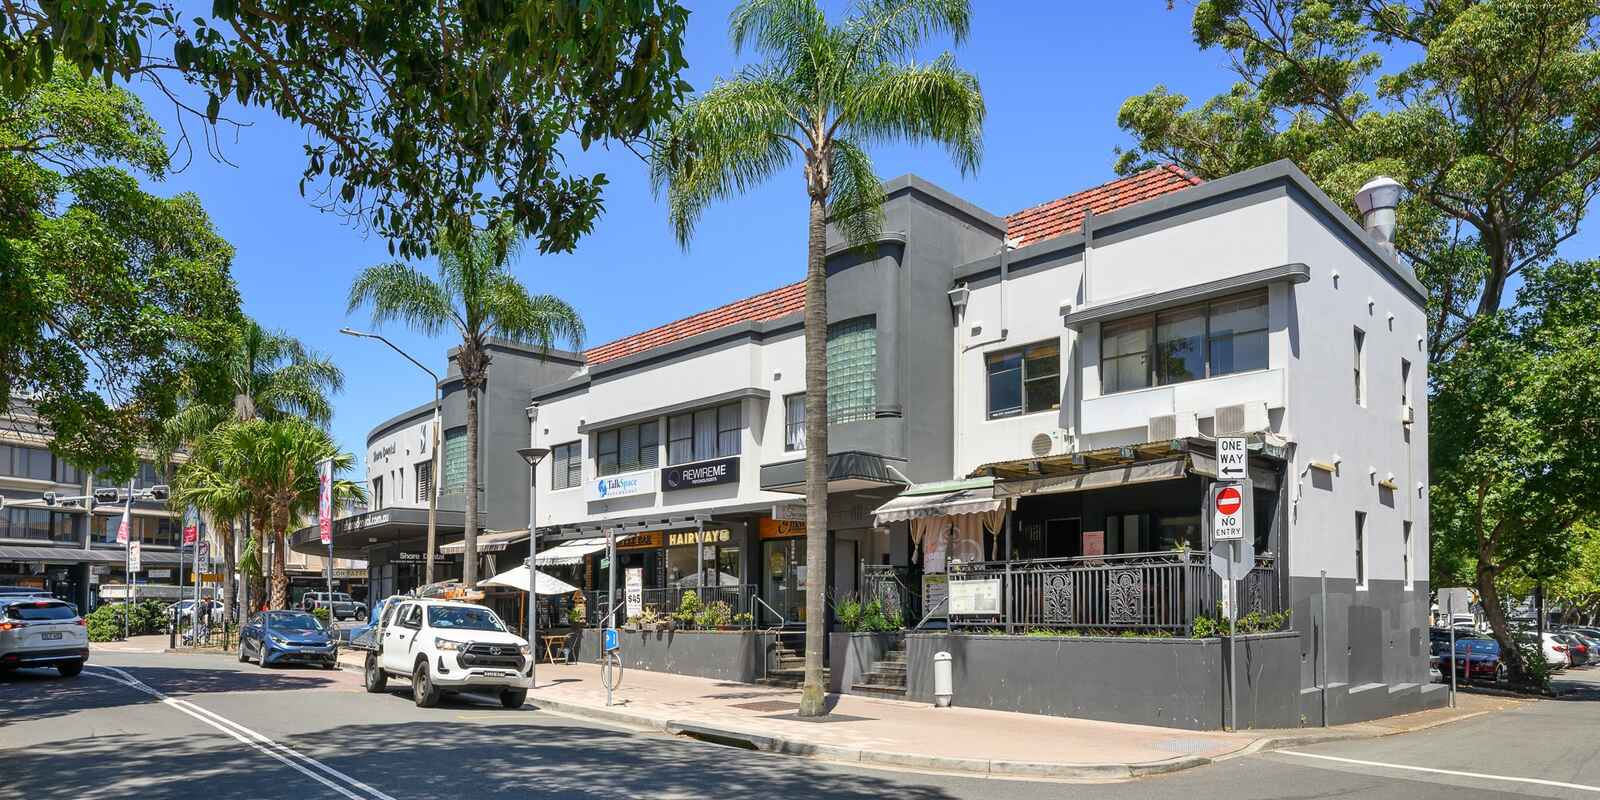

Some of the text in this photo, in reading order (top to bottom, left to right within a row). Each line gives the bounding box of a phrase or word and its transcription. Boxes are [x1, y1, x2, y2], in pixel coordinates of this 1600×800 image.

[1222, 440, 1242, 451] ONE
[1220, 454, 1243, 464] WAY
[682, 464, 727, 481] REWIREME
[607, 478, 640, 490] TalkSpace
[1221, 517, 1236, 527] NO
[1216, 527, 1241, 537] ENTRY
[669, 529, 720, 546] HAIRWAY
[628, 594, 641, 604] $45
